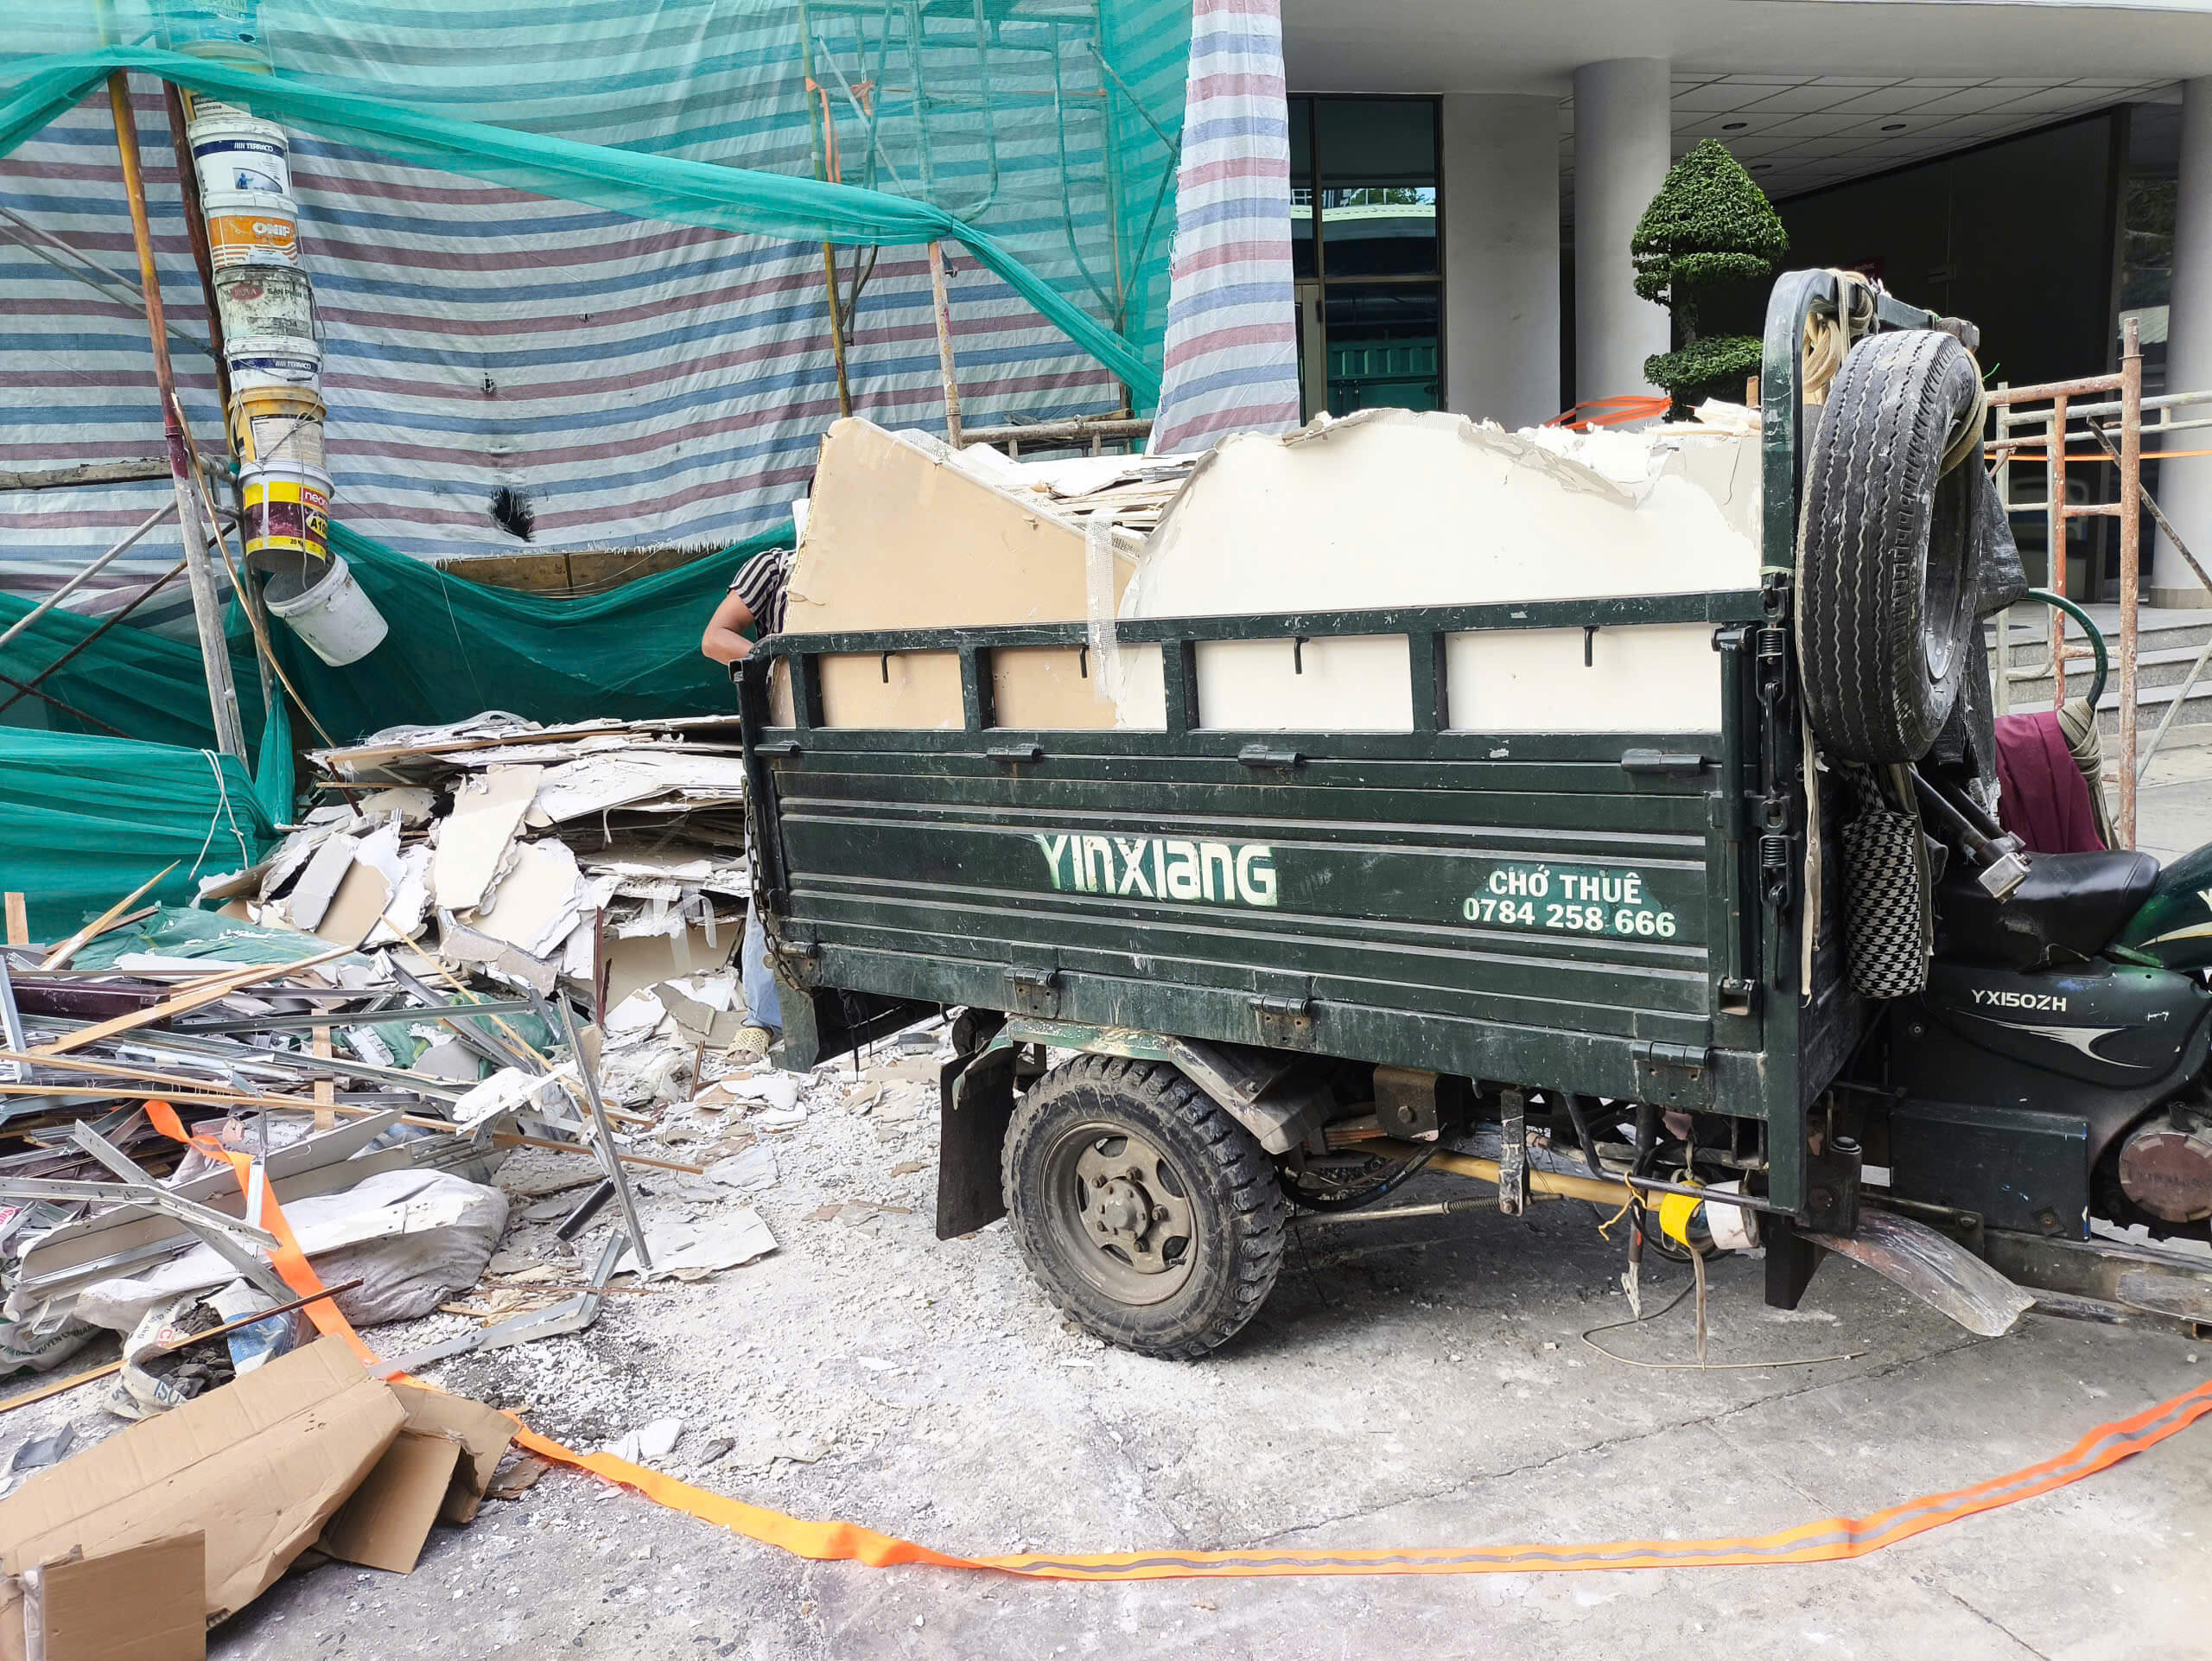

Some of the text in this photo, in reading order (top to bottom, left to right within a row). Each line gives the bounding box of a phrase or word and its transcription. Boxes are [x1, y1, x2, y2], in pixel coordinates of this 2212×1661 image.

[1559, 871, 1643, 905] THUÊ
[1463, 897, 1676, 938] 0784 258 666
[1971, 989, 2068, 1012] YX150ZH
